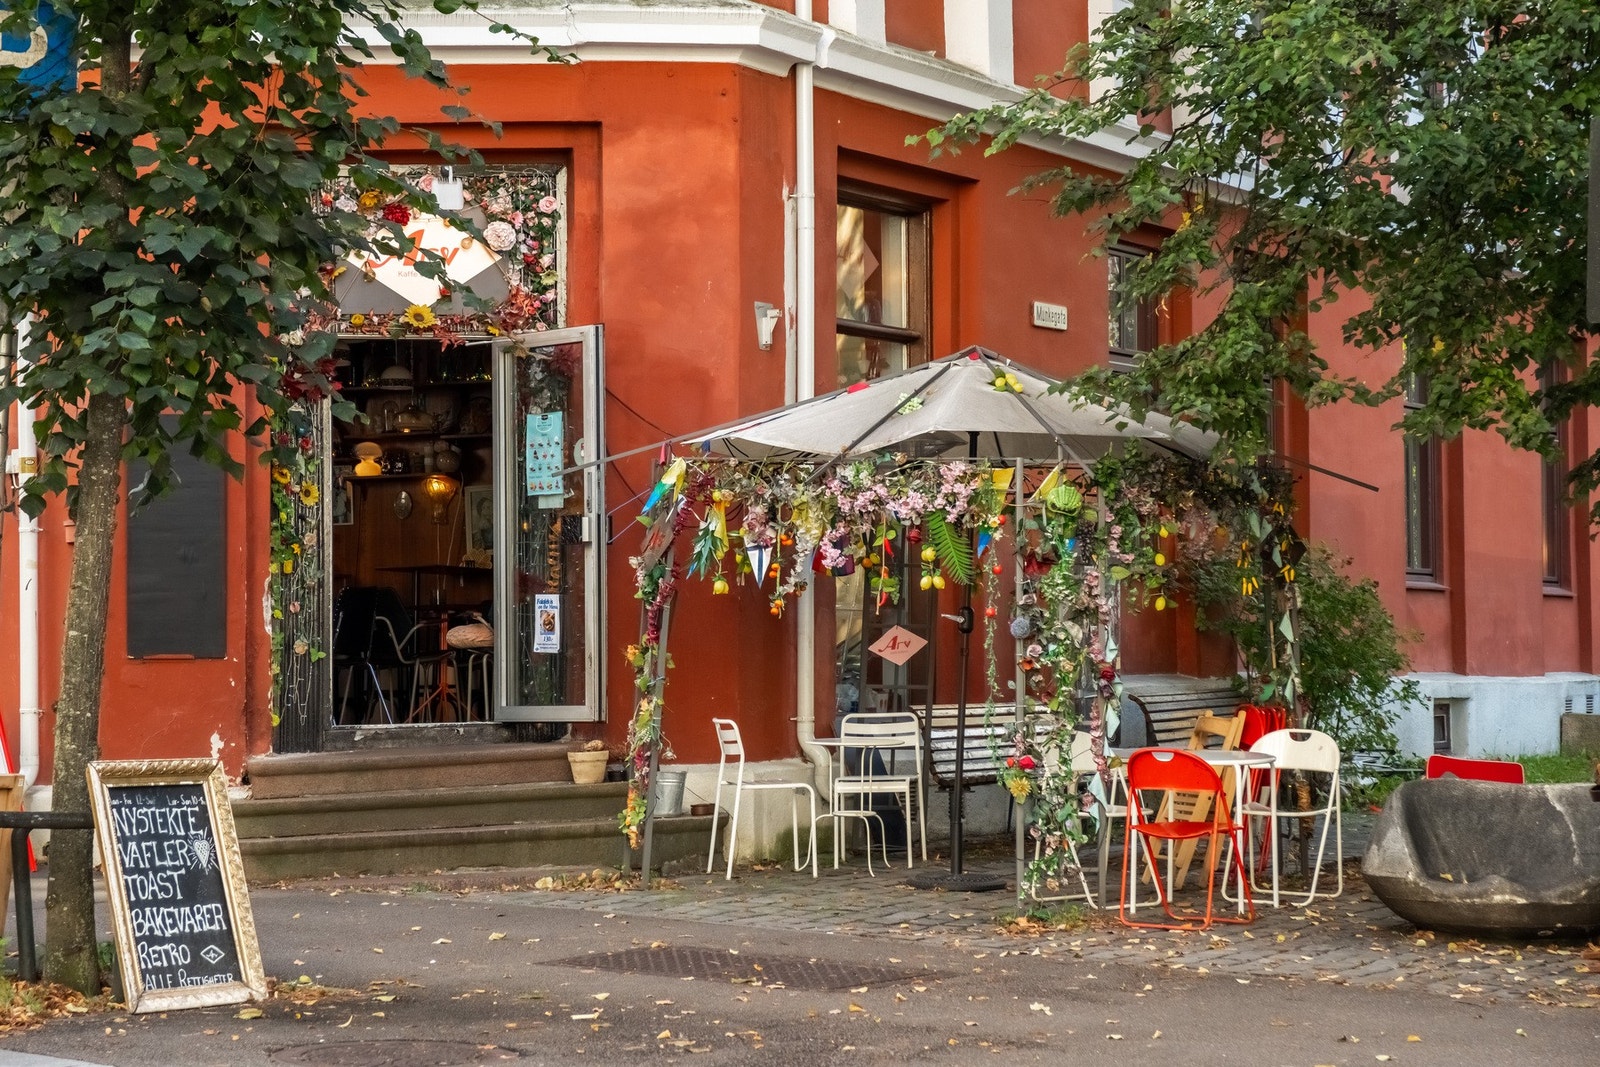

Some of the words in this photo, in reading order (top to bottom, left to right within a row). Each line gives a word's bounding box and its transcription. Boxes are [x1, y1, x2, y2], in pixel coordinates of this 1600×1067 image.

[1036, 305, 1065, 326] Munkegata
[878, 635, 911, 652] Arv
[112, 806, 203, 837] NYSTEKTE
[119, 840, 191, 868] VAFLER
[123, 869, 186, 901] TOAST
[131, 903, 227, 937] BAKEVARER
[137, 941, 191, 969] RETRO
